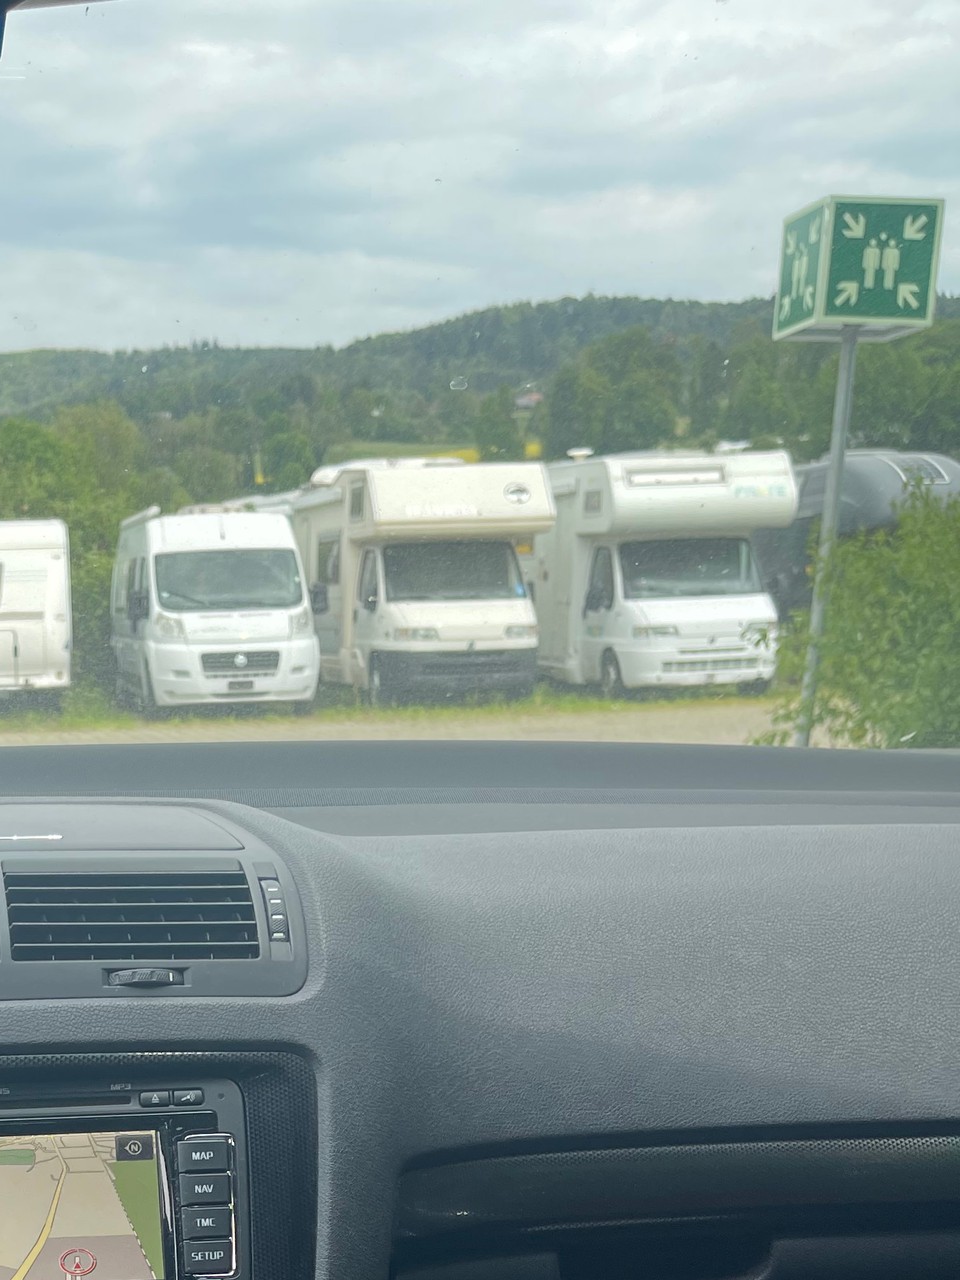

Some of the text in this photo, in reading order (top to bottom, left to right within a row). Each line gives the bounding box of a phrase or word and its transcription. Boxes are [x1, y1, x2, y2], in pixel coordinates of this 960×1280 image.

[110, 1083, 132, 1091] MP3
[191, 1151, 214, 1161] MAP
[194, 1184, 214, 1194] NAV
[196, 1218, 216, 1227] TMC
[191, 1251, 224, 1261] SETUP
